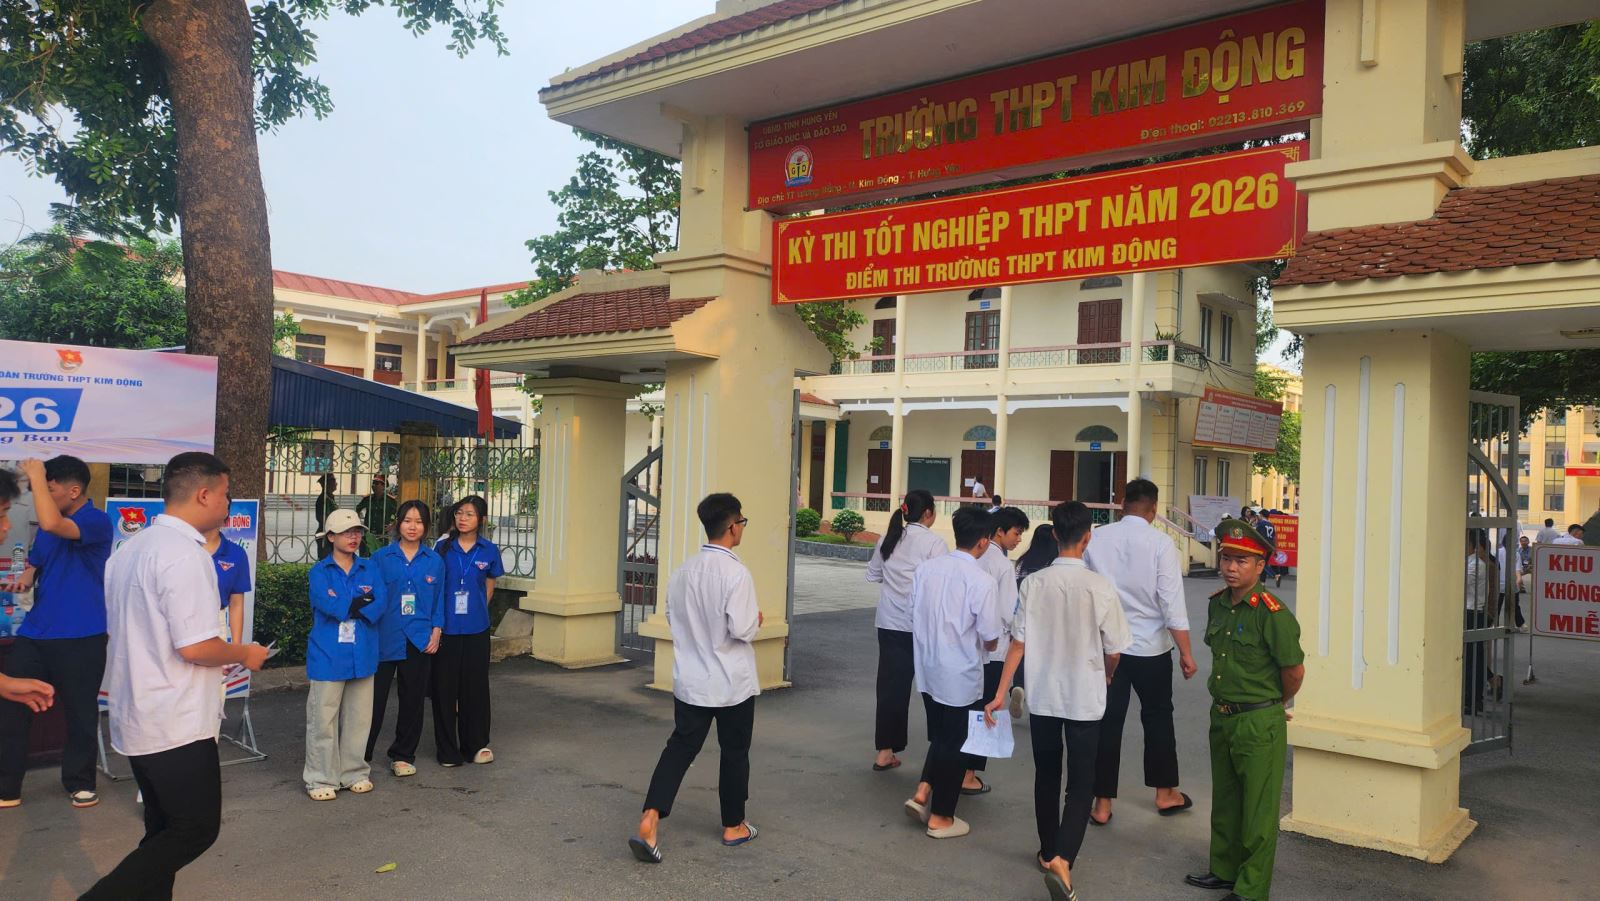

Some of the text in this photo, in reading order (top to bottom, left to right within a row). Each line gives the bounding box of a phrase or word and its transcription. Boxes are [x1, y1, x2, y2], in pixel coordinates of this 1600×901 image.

[859, 27, 1306, 160] TRƯỜNG THPT KIM ĐỘNG
[1170, 119, 1204, 135] thoại:
[858, 179, 874, 188] Kim
[877, 173, 899, 186] Động
[788, 172, 1279, 265] KỲ THI TỐT NGHIỆP THPT NĂM 2026
[846, 237, 1177, 290] ĐIỂM THI TRƯỜNG THPT KIM ĐỘNG
[23, 370, 64, 382] TRƯỜNG
[67, 375, 91, 384] THPT
[94, 377, 113, 385] KIM
[116, 377, 143, 387] ĐỘNG
[23, 434, 69, 444] Bạn
[233, 514, 250, 530] ĐỘNG
[1548, 554, 1593, 574] KHU
[1544, 580, 1600, 603] KHÔNG
